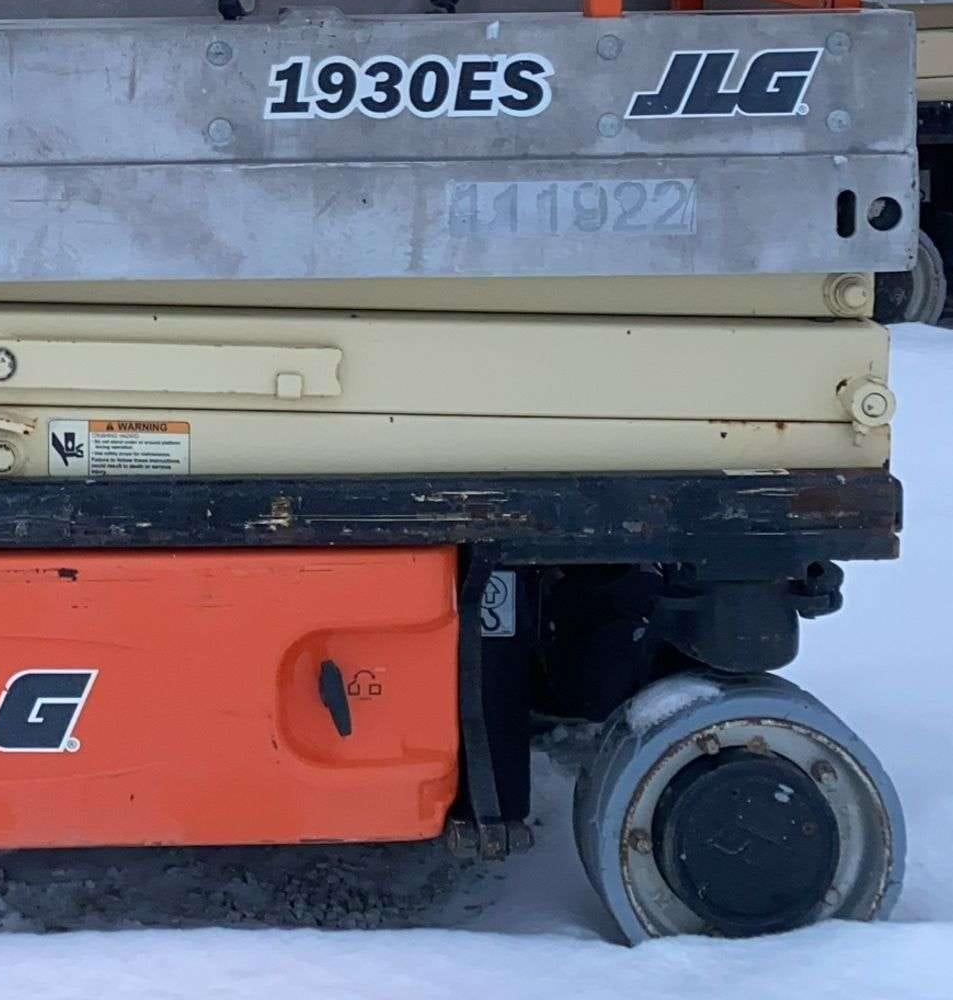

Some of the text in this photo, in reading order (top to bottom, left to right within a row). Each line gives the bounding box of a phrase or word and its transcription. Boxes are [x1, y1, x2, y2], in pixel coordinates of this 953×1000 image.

[263, 51, 555, 121] 1930ES
[624, 46, 824, 121] JLG
[117, 423, 168, 432] WARNING
